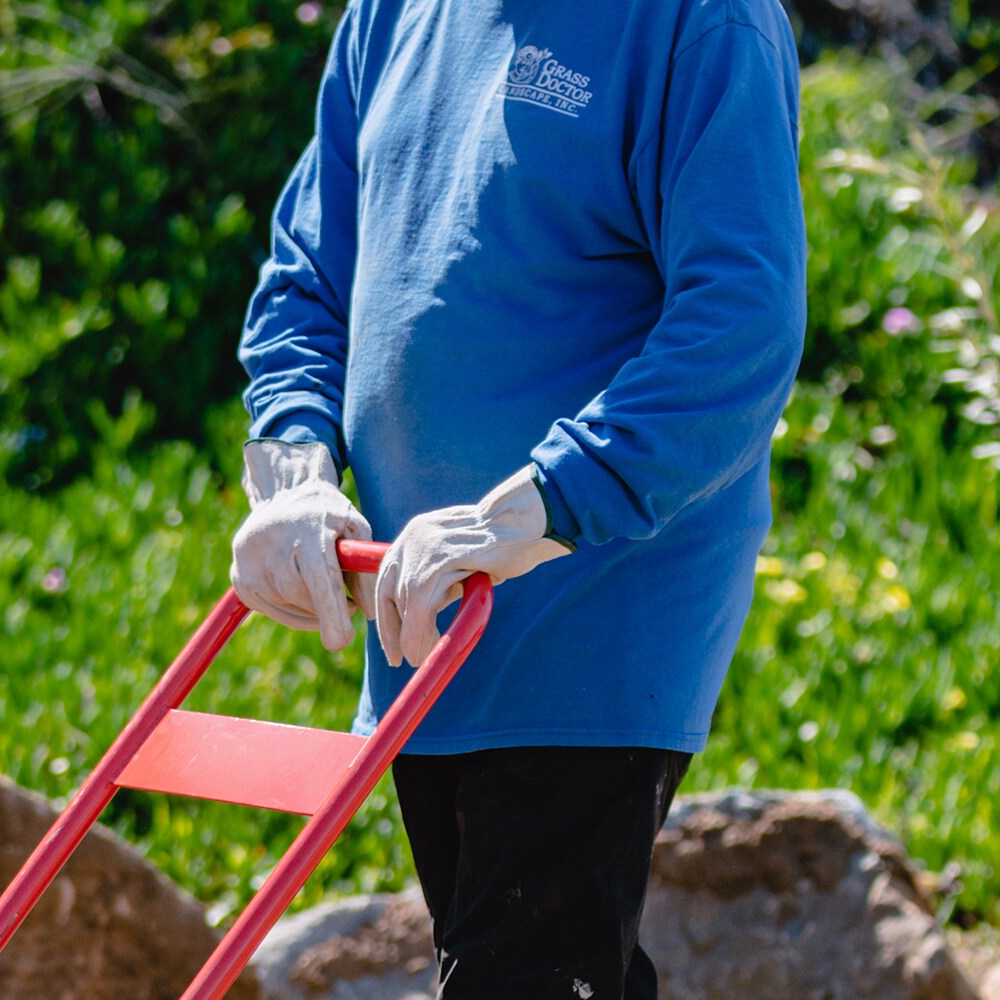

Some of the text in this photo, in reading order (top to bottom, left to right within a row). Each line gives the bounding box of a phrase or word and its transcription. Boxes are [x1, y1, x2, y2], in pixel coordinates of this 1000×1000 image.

[535, 71, 593, 104] DOCTOR
[543, 59, 591, 88] GRASS
[555, 99, 579, 113] INC.
